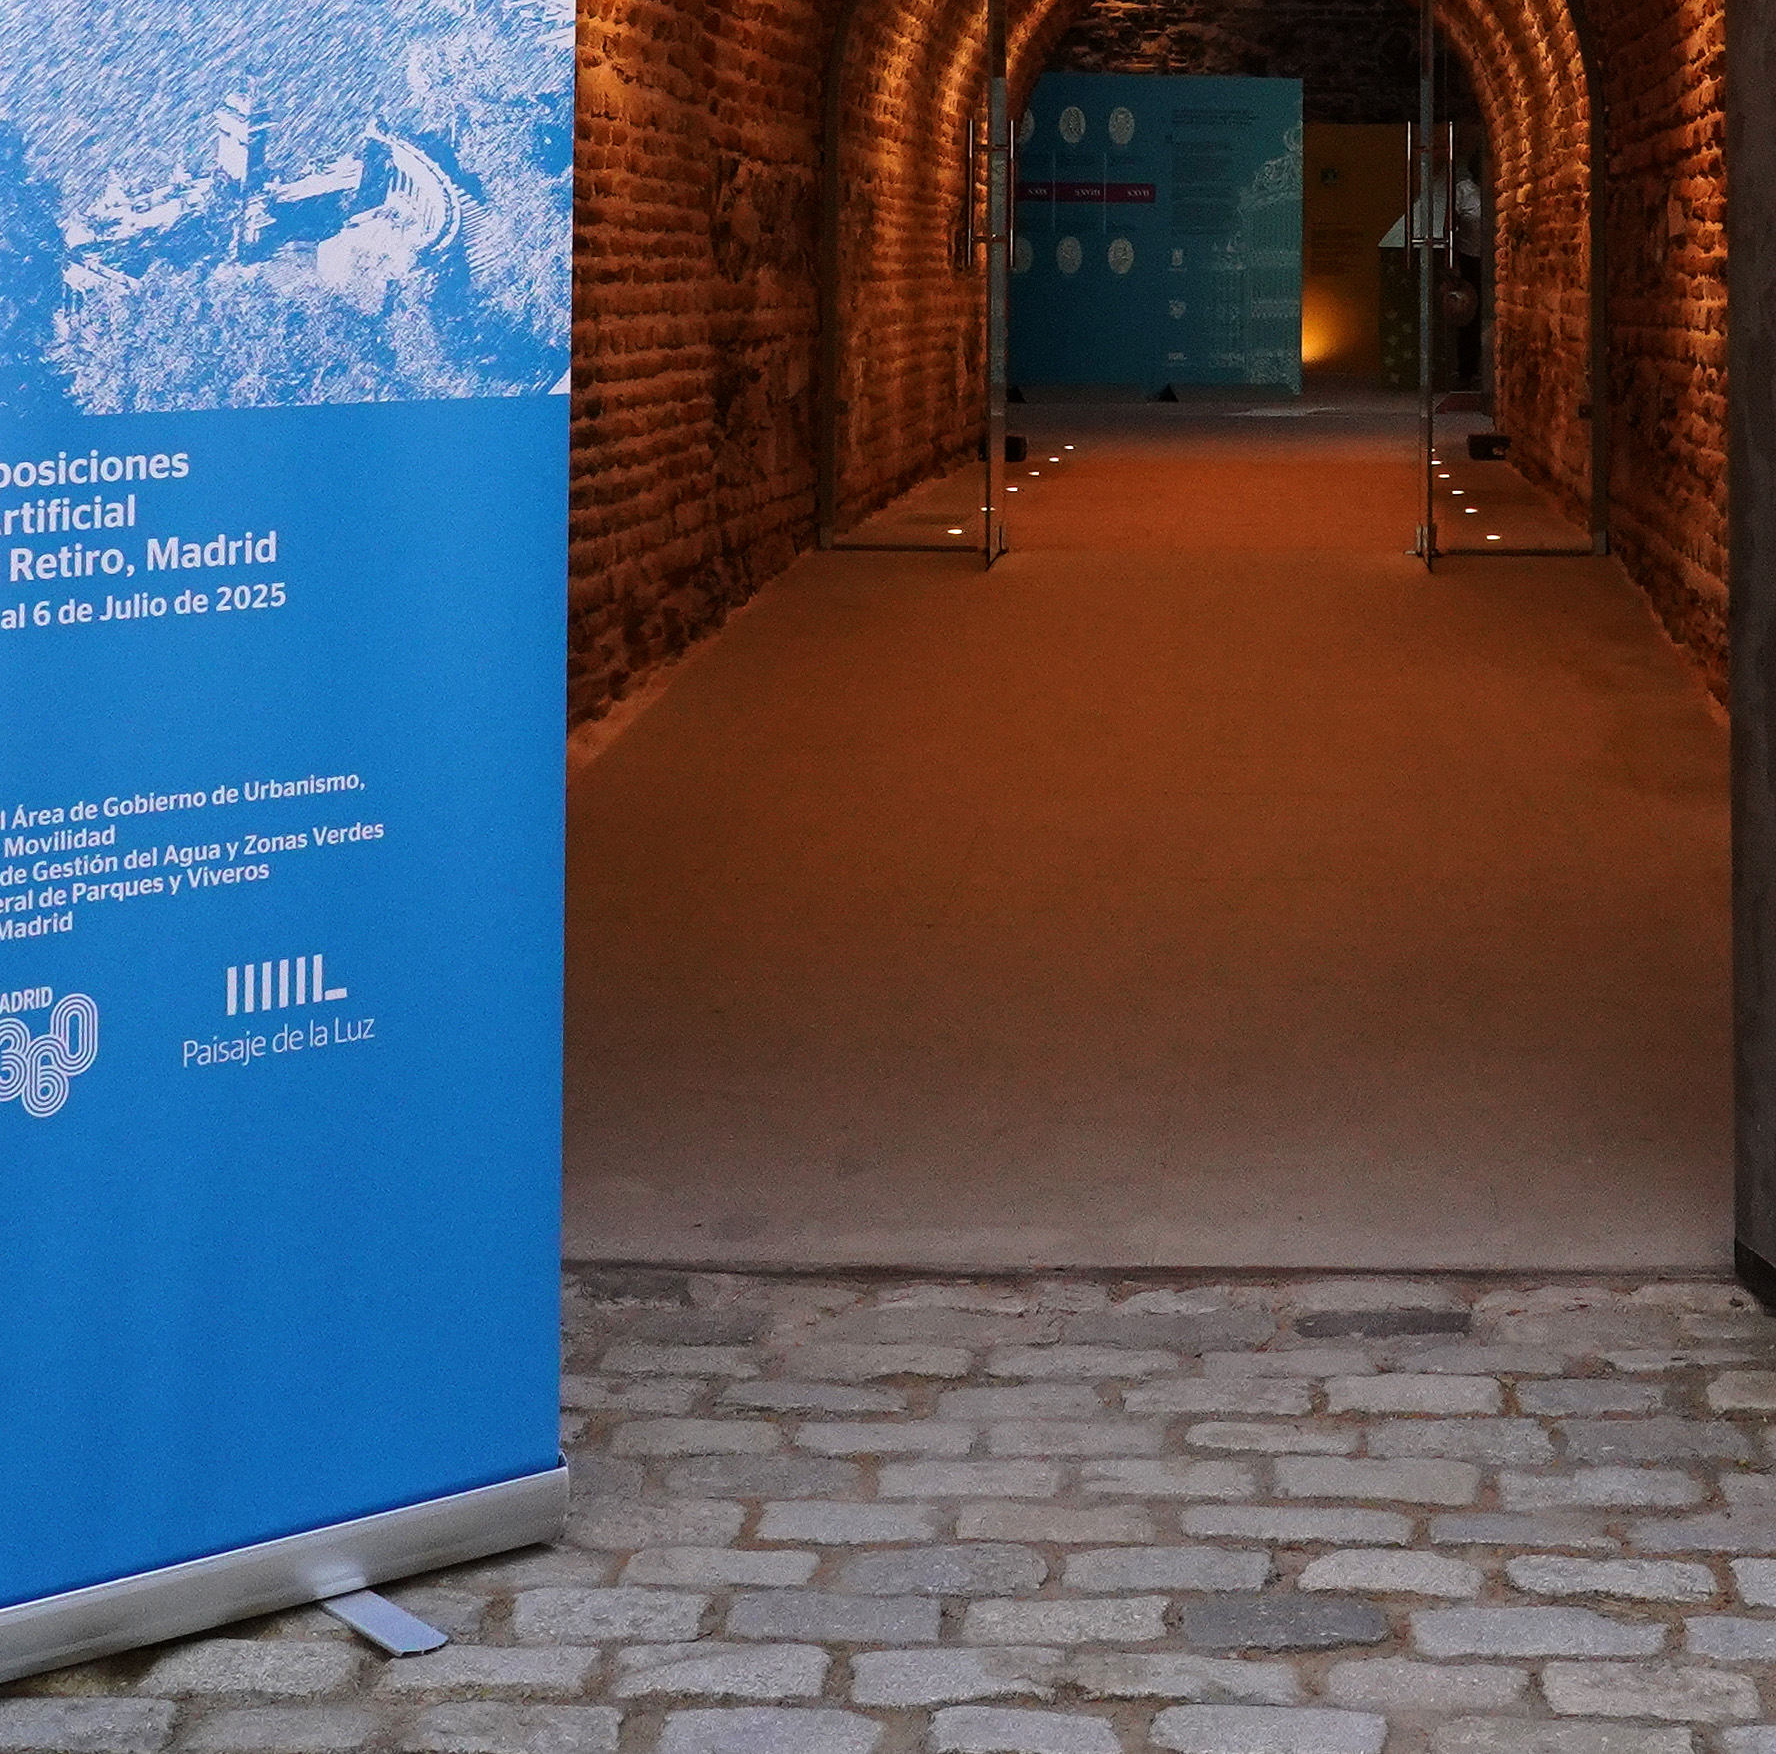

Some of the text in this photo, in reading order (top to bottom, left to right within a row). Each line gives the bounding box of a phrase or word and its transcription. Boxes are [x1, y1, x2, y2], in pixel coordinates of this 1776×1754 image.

[10, 544, 136, 581] Retiro,
[147, 531, 278, 572] Madrid
[1, 603, 26, 629] al
[32, 602, 50, 626] 6
[58, 598, 93, 623] de
[98, 592, 167, 620] Julio
[174, 590, 209, 615] de
[216, 582, 286, 611] 2025
[11, 804, 65, 829] Área
[69, 799, 98, 822] de
[103, 789, 207, 819] Gobierno
[212, 784, 239, 805] de
[243, 770, 365, 801] Urbanismo,
[4, 825, 115, 858] Movilidad
[32, 851, 118, 882] Gestión
[123, 844, 158, 869] del
[163, 838, 221, 869] Agua
[226, 840, 239, 860] y
[243, 831, 308, 856] Zonas
[312, 820, 384, 846] Verdes
[38, 885, 67, 908] de
[72, 875, 164, 909] Parques
[168, 875, 182, 894] y
[187, 861, 270, 888] Viveros
[182, 1014, 376, 1067] Paisaje de la Luz
